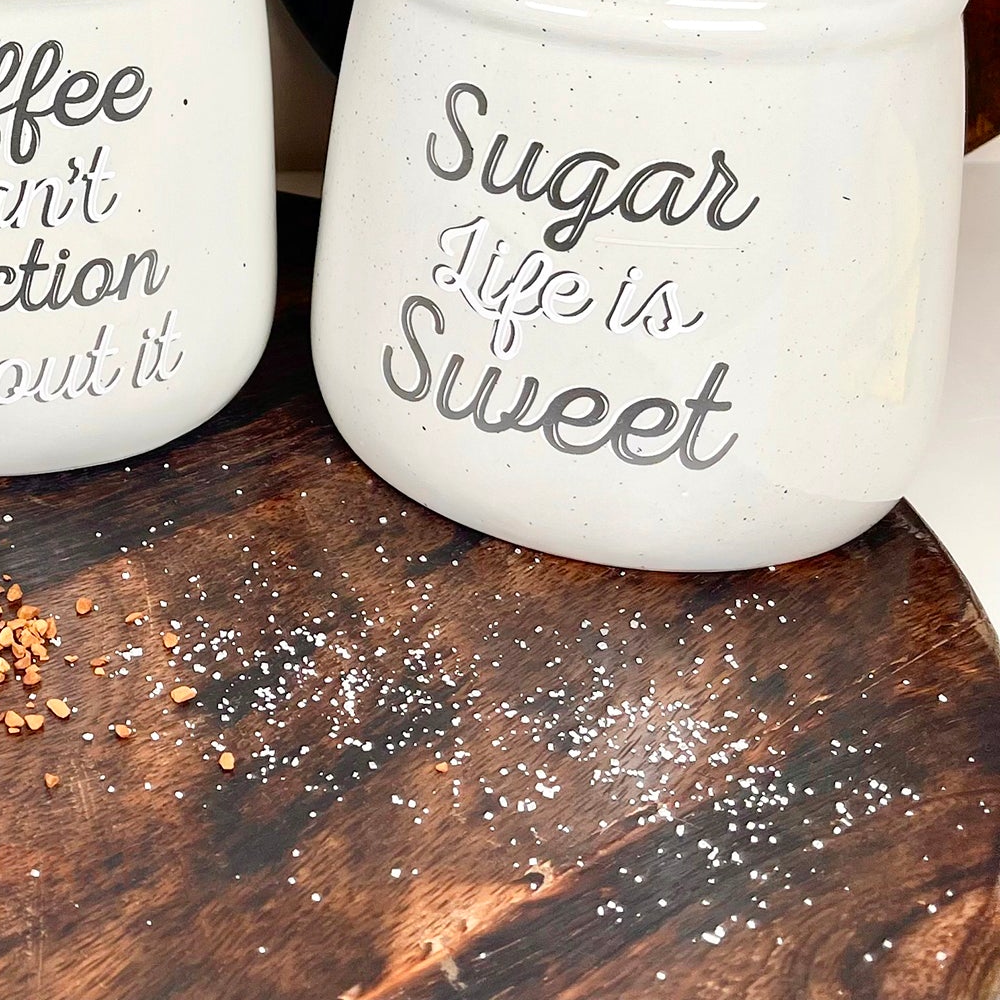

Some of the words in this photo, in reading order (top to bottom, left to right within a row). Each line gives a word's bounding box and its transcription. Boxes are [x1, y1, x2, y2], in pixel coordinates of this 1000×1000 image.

[426, 82, 760, 251] Sugar
[132, 309, 183, 388] it
[432, 215, 594, 359] Life
[605, 266, 704, 338] is
[383, 295, 739, 470] Sweet
